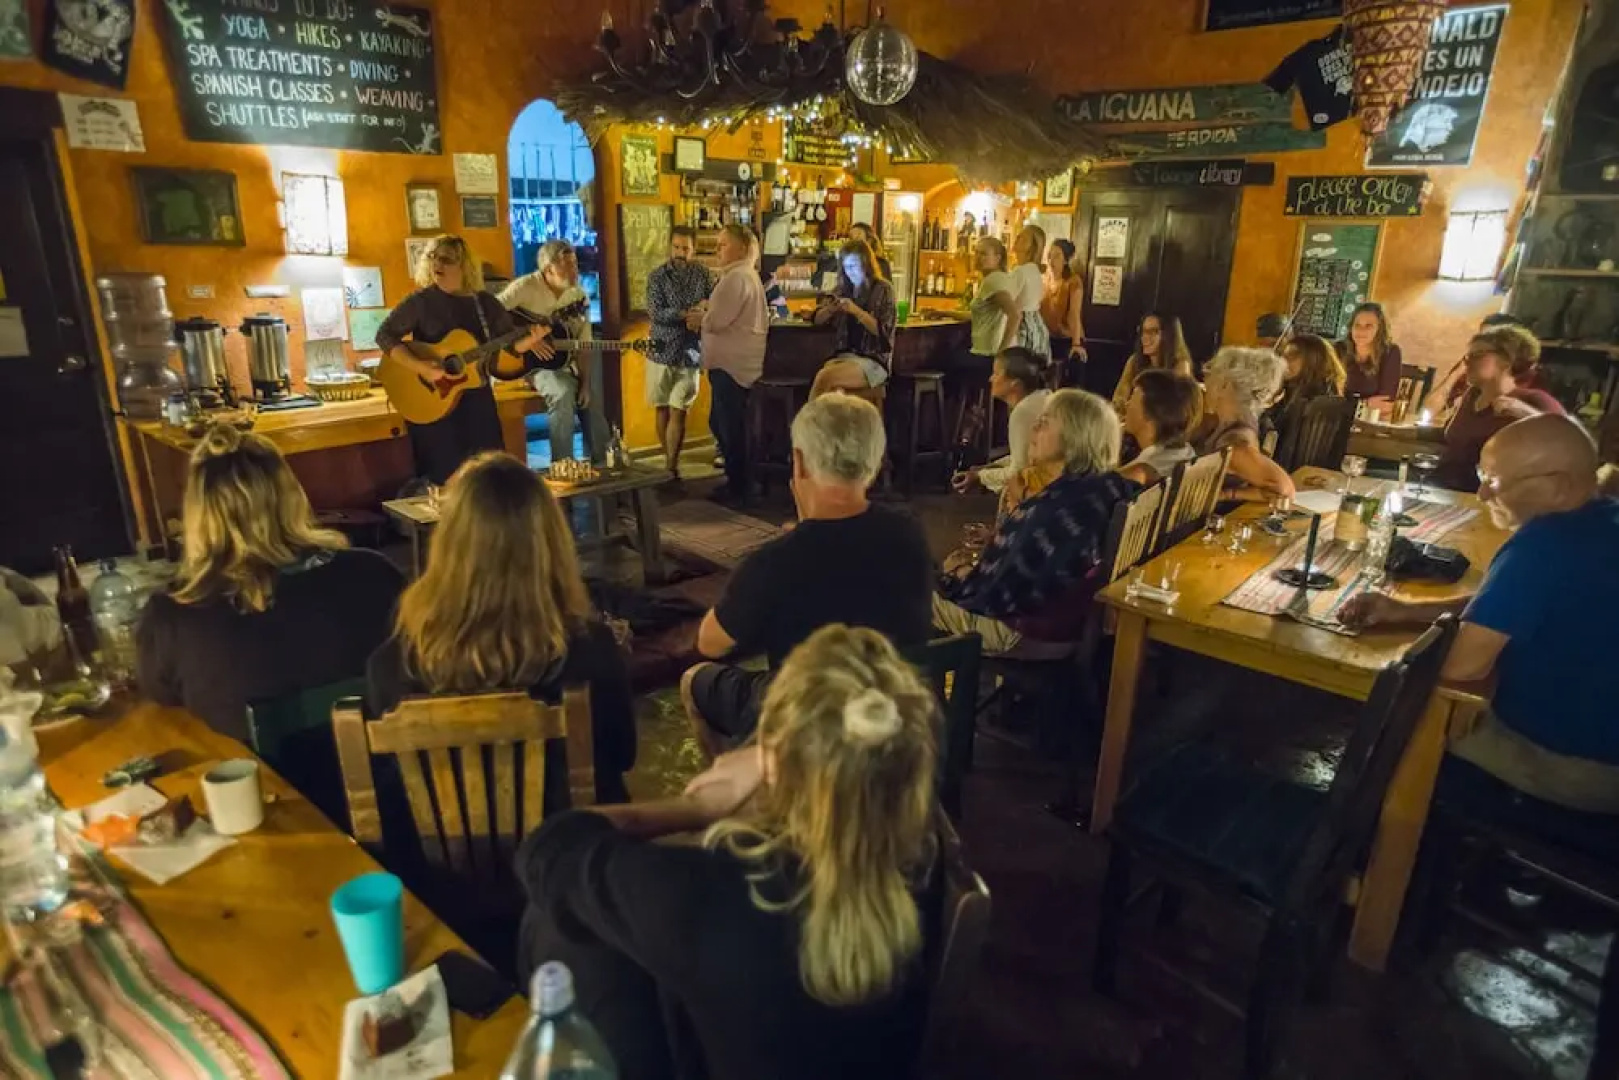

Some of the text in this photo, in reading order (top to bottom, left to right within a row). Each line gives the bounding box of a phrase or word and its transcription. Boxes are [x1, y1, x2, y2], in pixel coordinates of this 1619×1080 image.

[222, 14, 425, 58] YOGA HIKES KAYAKING
[1427, 11, 1498, 44] NALD
[187, 44, 399, 82] SPA TREATMENTS DIVING
[1454, 44, 1484, 69] UN
[191, 73, 424, 112] SPANISH CLASSES WEAVING
[1408, 72, 1484, 99] NDEJO
[206, 101, 299, 129] SHUTTLES
[361, 114, 379, 127] FOR
[1099, 90, 1196, 121] IGUANA
[1336, 195, 1362, 215] the
[1366, 196, 1391, 215] bar
